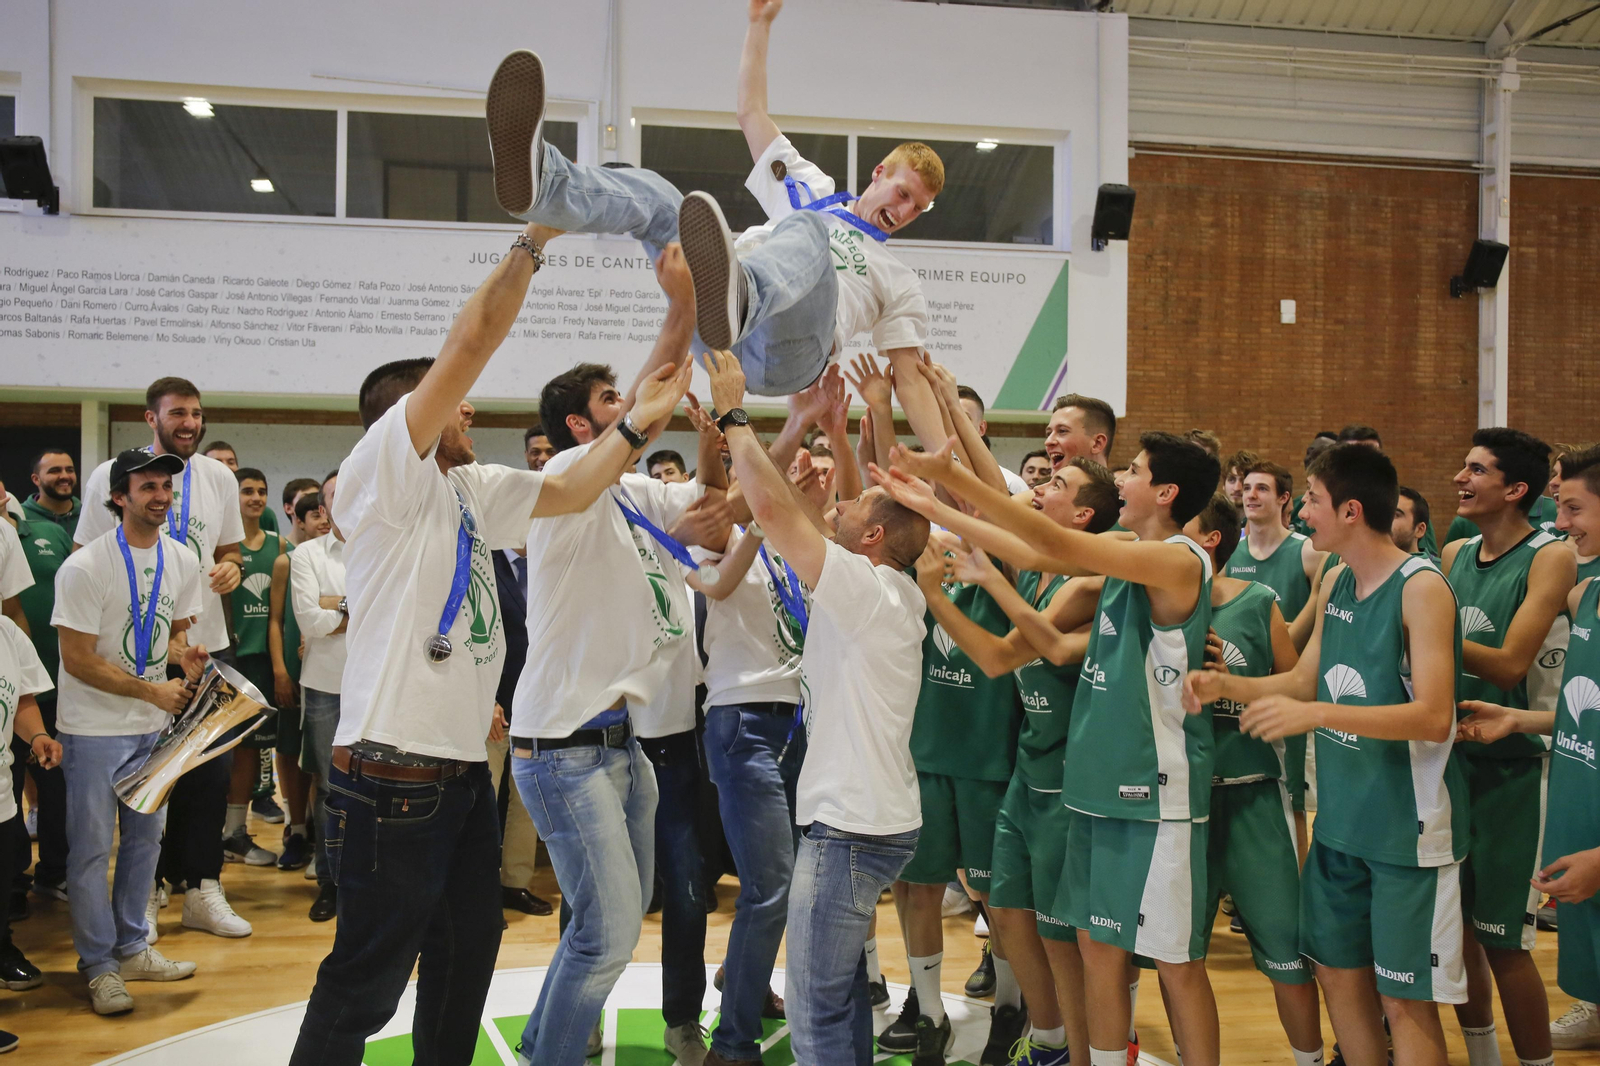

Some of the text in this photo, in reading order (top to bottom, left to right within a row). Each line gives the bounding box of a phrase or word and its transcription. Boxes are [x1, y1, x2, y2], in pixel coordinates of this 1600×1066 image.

[469, 252, 653, 270] JUGES DE CANTE
[56, 269, 79, 280] Paco
[81, 270, 112, 281] Ramos
[114, 271, 140, 282] Llorca
[147, 272, 180, 283] Damián
[182, 274, 215, 285] Caneda
[222, 275, 254, 286] Ricardo
[256, 277, 289, 288] Galeote
[296, 278, 320, 291] Diego
[322, 279, 352, 290] Gómez
[358, 280, 378, 291] Rafa
[380, 281, 401, 292] Pozo
[407, 282, 427, 293] José
[428, 283, 458, 294] Antonio
[460, 284, 479, 295] Sán
[970, 271, 1026, 285] EQUIPO
[19, 282, 48, 295] Miguel
[50, 281, 76, 296] Ángel
[108, 286, 128, 296] Lara
[135, 287, 156, 297] José
[158, 287, 185, 298] Carlos
[187, 289, 219, 301] Gaspar
[225, 290, 246, 301] José
[247, 291, 279, 302] Antonio
[280, 292, 313, 304] Villegas
[319, 294, 358, 305] Fernando
[360, 295, 381, 305] Vidal
[387, 296, 420, 307] Juanma
[421, 297, 450, 308] Gómez
[531, 285, 554, 297] Ángel
[556, 286, 585, 298] Álvarez
[609, 289, 633, 299] Pedro
[13, 297, 53, 310] Pequeño
[60, 299, 81, 309] Dani
[83, 300, 117, 310] Romero
[124, 301, 149, 312] Curro
[150, 301, 179, 313] Ávalos
[186, 303, 209, 316] Gaby
[211, 304, 230, 315] Ruiz
[237, 306, 264, 316] Nacho
[315, 308, 346, 319] Antonio
[347, 307, 374, 319] Álamo
[380, 310, 411, 321] Ernesto
[413, 311, 446, 322] Serrano
[525, 301, 556, 311] Antonio
[557, 302, 578, 312] Rosa
[584, 302, 603, 312] José
[605, 303, 631, 314] Miguel
[927, 300, 975, 311] Miguel Pérez
[0, 313, 22, 323] arcos
[24, 312, 63, 324] Baltanás
[70, 314, 91, 325] Rafa
[93, 315, 126, 326] Huertas
[133, 316, 158, 327] Pavel
[209, 319, 242, 330] Alfonso
[243, 320, 279, 332] Sánchez
[350, 324, 373, 334] Pablo
[375, 325, 403, 335] Movilla
[410, 326, 438, 336] Paulao
[563, 316, 585, 328] Fredy
[588, 317, 625, 327] Navarrete
[632, 318, 654, 328] David
[0, 328, 316, 347] omas Sabonis Romaric Belemene Mo Soluade Viny Okouo Cristian Uta
[523, 329, 539, 338] Miki
[541, 330, 572, 340] Servera
[578, 331, 596, 341] Rafa
[598, 331, 622, 341] Freire
[627, 332, 659, 343] Augusto
[930, 327, 957, 338] Gómez
[935, 341, 962, 351] Abrines
[928, 664, 972, 684] Unicaja
[1213, 698, 1246, 714] caja
[1556, 729, 1596, 761] Unicaja
[969, 867, 992, 879] SPALD
[1090, 914, 1122, 934] ALDING
[1265, 958, 1303, 971] SPALDING
[1374, 960, 1415, 984] PALDING
